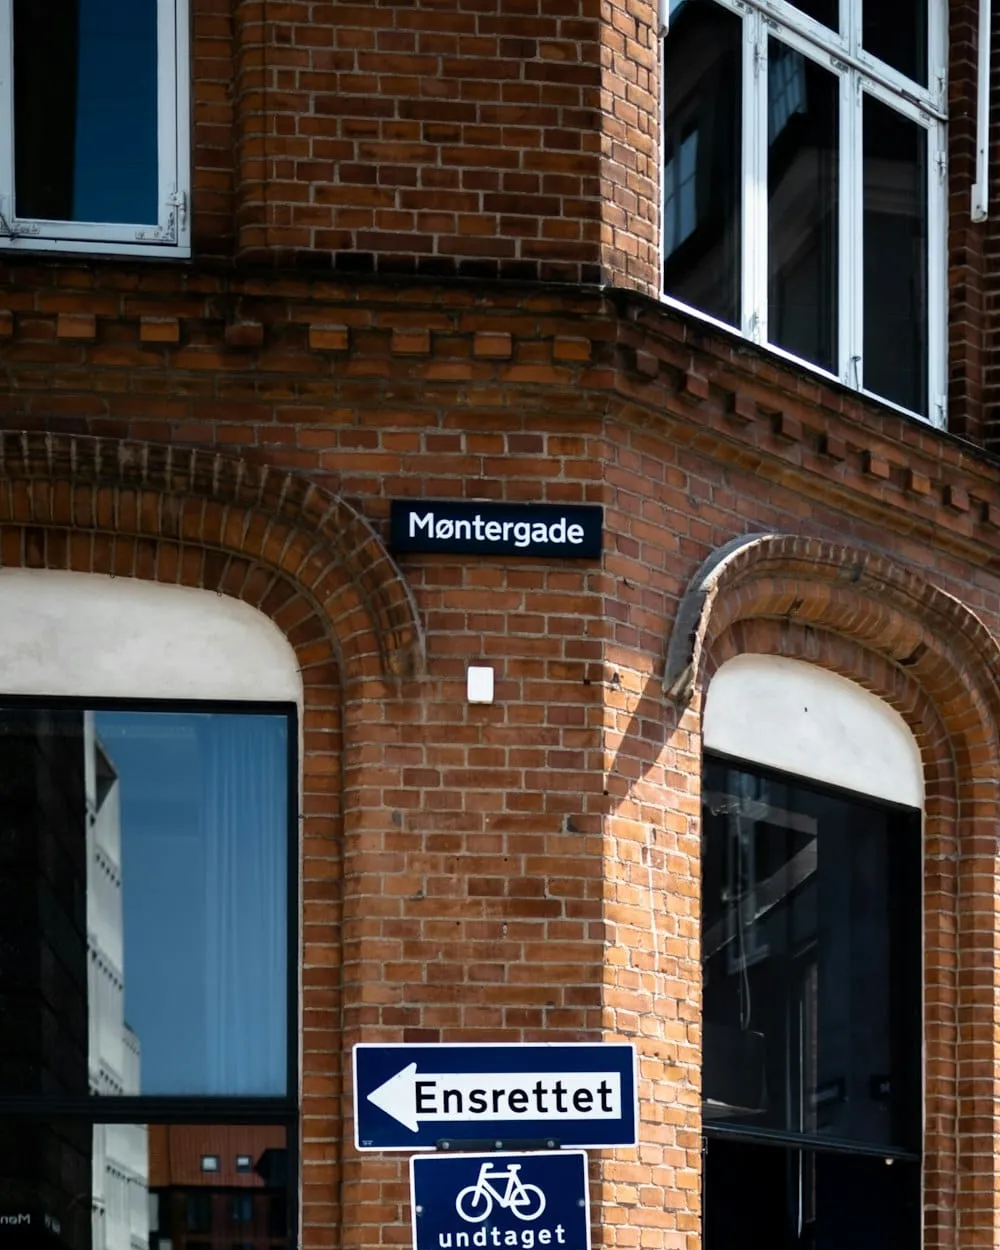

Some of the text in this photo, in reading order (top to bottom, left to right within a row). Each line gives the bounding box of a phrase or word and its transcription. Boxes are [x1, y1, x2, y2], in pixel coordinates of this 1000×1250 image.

[409, 511, 585, 547] Møntergade
[415, 1080, 613, 1114] Ensrettet
[438, 1224, 566, 1249] undtaget
